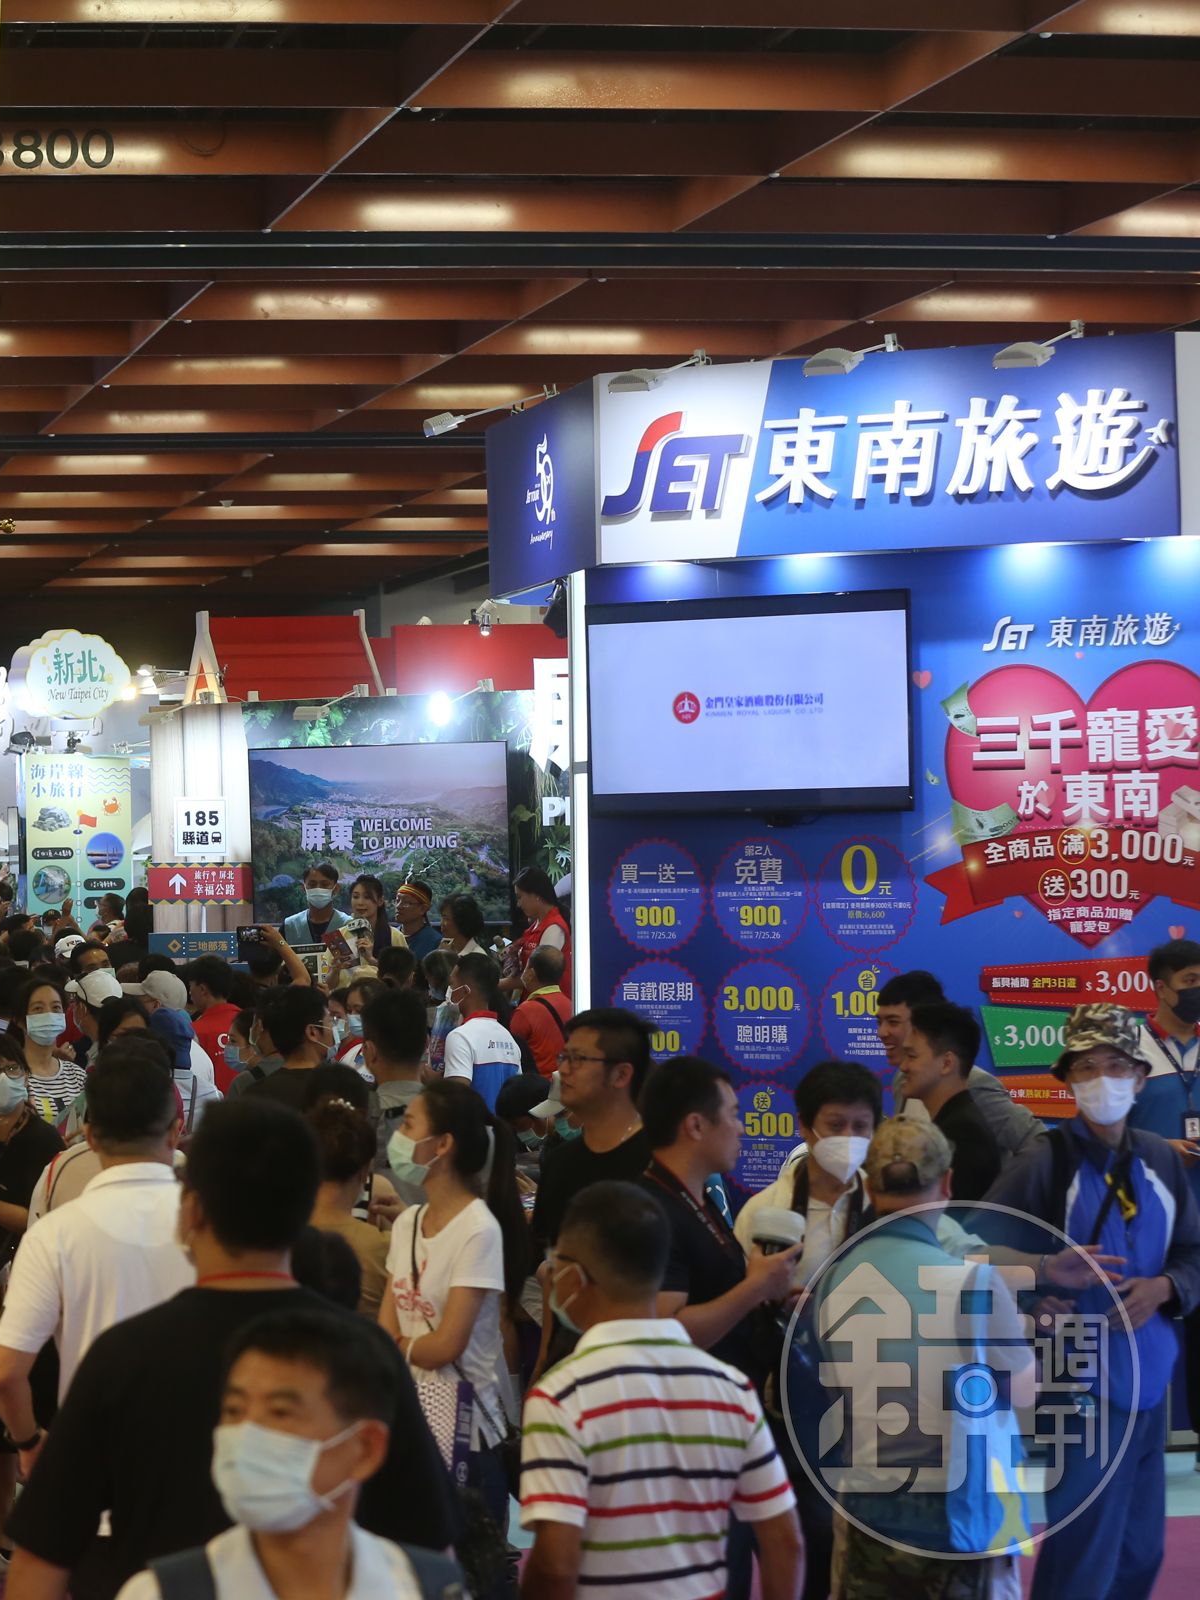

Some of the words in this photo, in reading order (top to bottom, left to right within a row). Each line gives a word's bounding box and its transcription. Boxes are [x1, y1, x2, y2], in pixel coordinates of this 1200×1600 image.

[754, 388, 1148, 509] 東南旅遊
[1046, 612, 1179, 648] 東南旅遊
[52, 648, 99, 686] 新北
[48, 688, 67, 700] New
[67, 687, 92, 703] Taipei
[93, 687, 109, 702] City
[972, 706, 1199, 770] 三千寵愛
[31, 782, 84, 799] 小旅行
[184, 810, 219, 826] 185
[360, 818, 432, 832] WELCOME
[182, 831, 210, 845] 縣道
[300, 819, 354, 850] 屏東
[361, 838, 379, 849] TO
[384, 835, 458, 849] PINGTUNG
[621, 863, 694, 884] 買一送一
[734, 857, 784, 885] 免費
[194, 884, 235, 896] 幸福公路
[635, 905, 676, 927] 900
[739, 905, 781, 927] 900
[622, 981, 694, 1002] 高鐵假期
[736, 1025, 789, 1044] 聰明購
